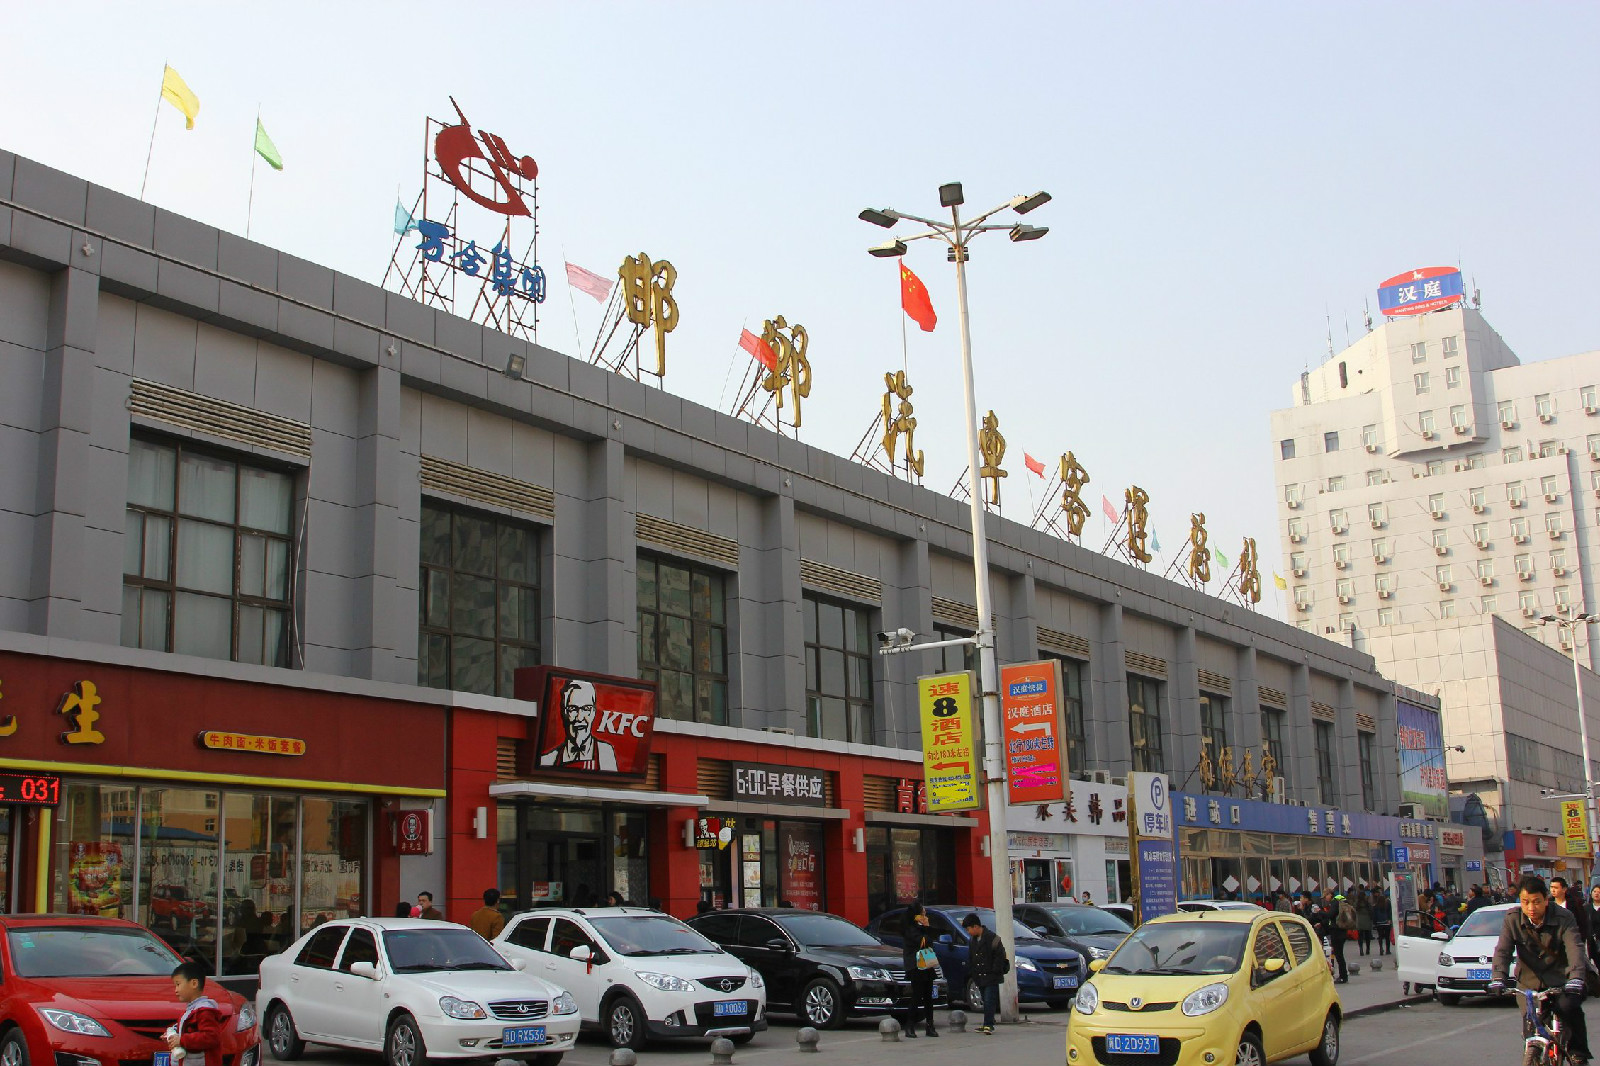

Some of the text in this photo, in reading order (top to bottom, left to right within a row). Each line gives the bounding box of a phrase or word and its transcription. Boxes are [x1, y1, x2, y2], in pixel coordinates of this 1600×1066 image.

[416, 219, 546, 304] 万合集团
[1398, 281, 1442, 304] 汉庭
[1012, 683, 1043, 695] 汉庭快捷
[597, 710, 648, 738] KFC
[928, 682, 962, 746] 速8酒店
[1008, 703, 1053, 719] 汉庭酒店
[735, 768, 823, 799] 6:00早餐供应
[1144, 812, 1169, 834] 停车场
[1184, 796, 1240, 824] 进站口
[1308, 809, 1351, 834] 售票处
